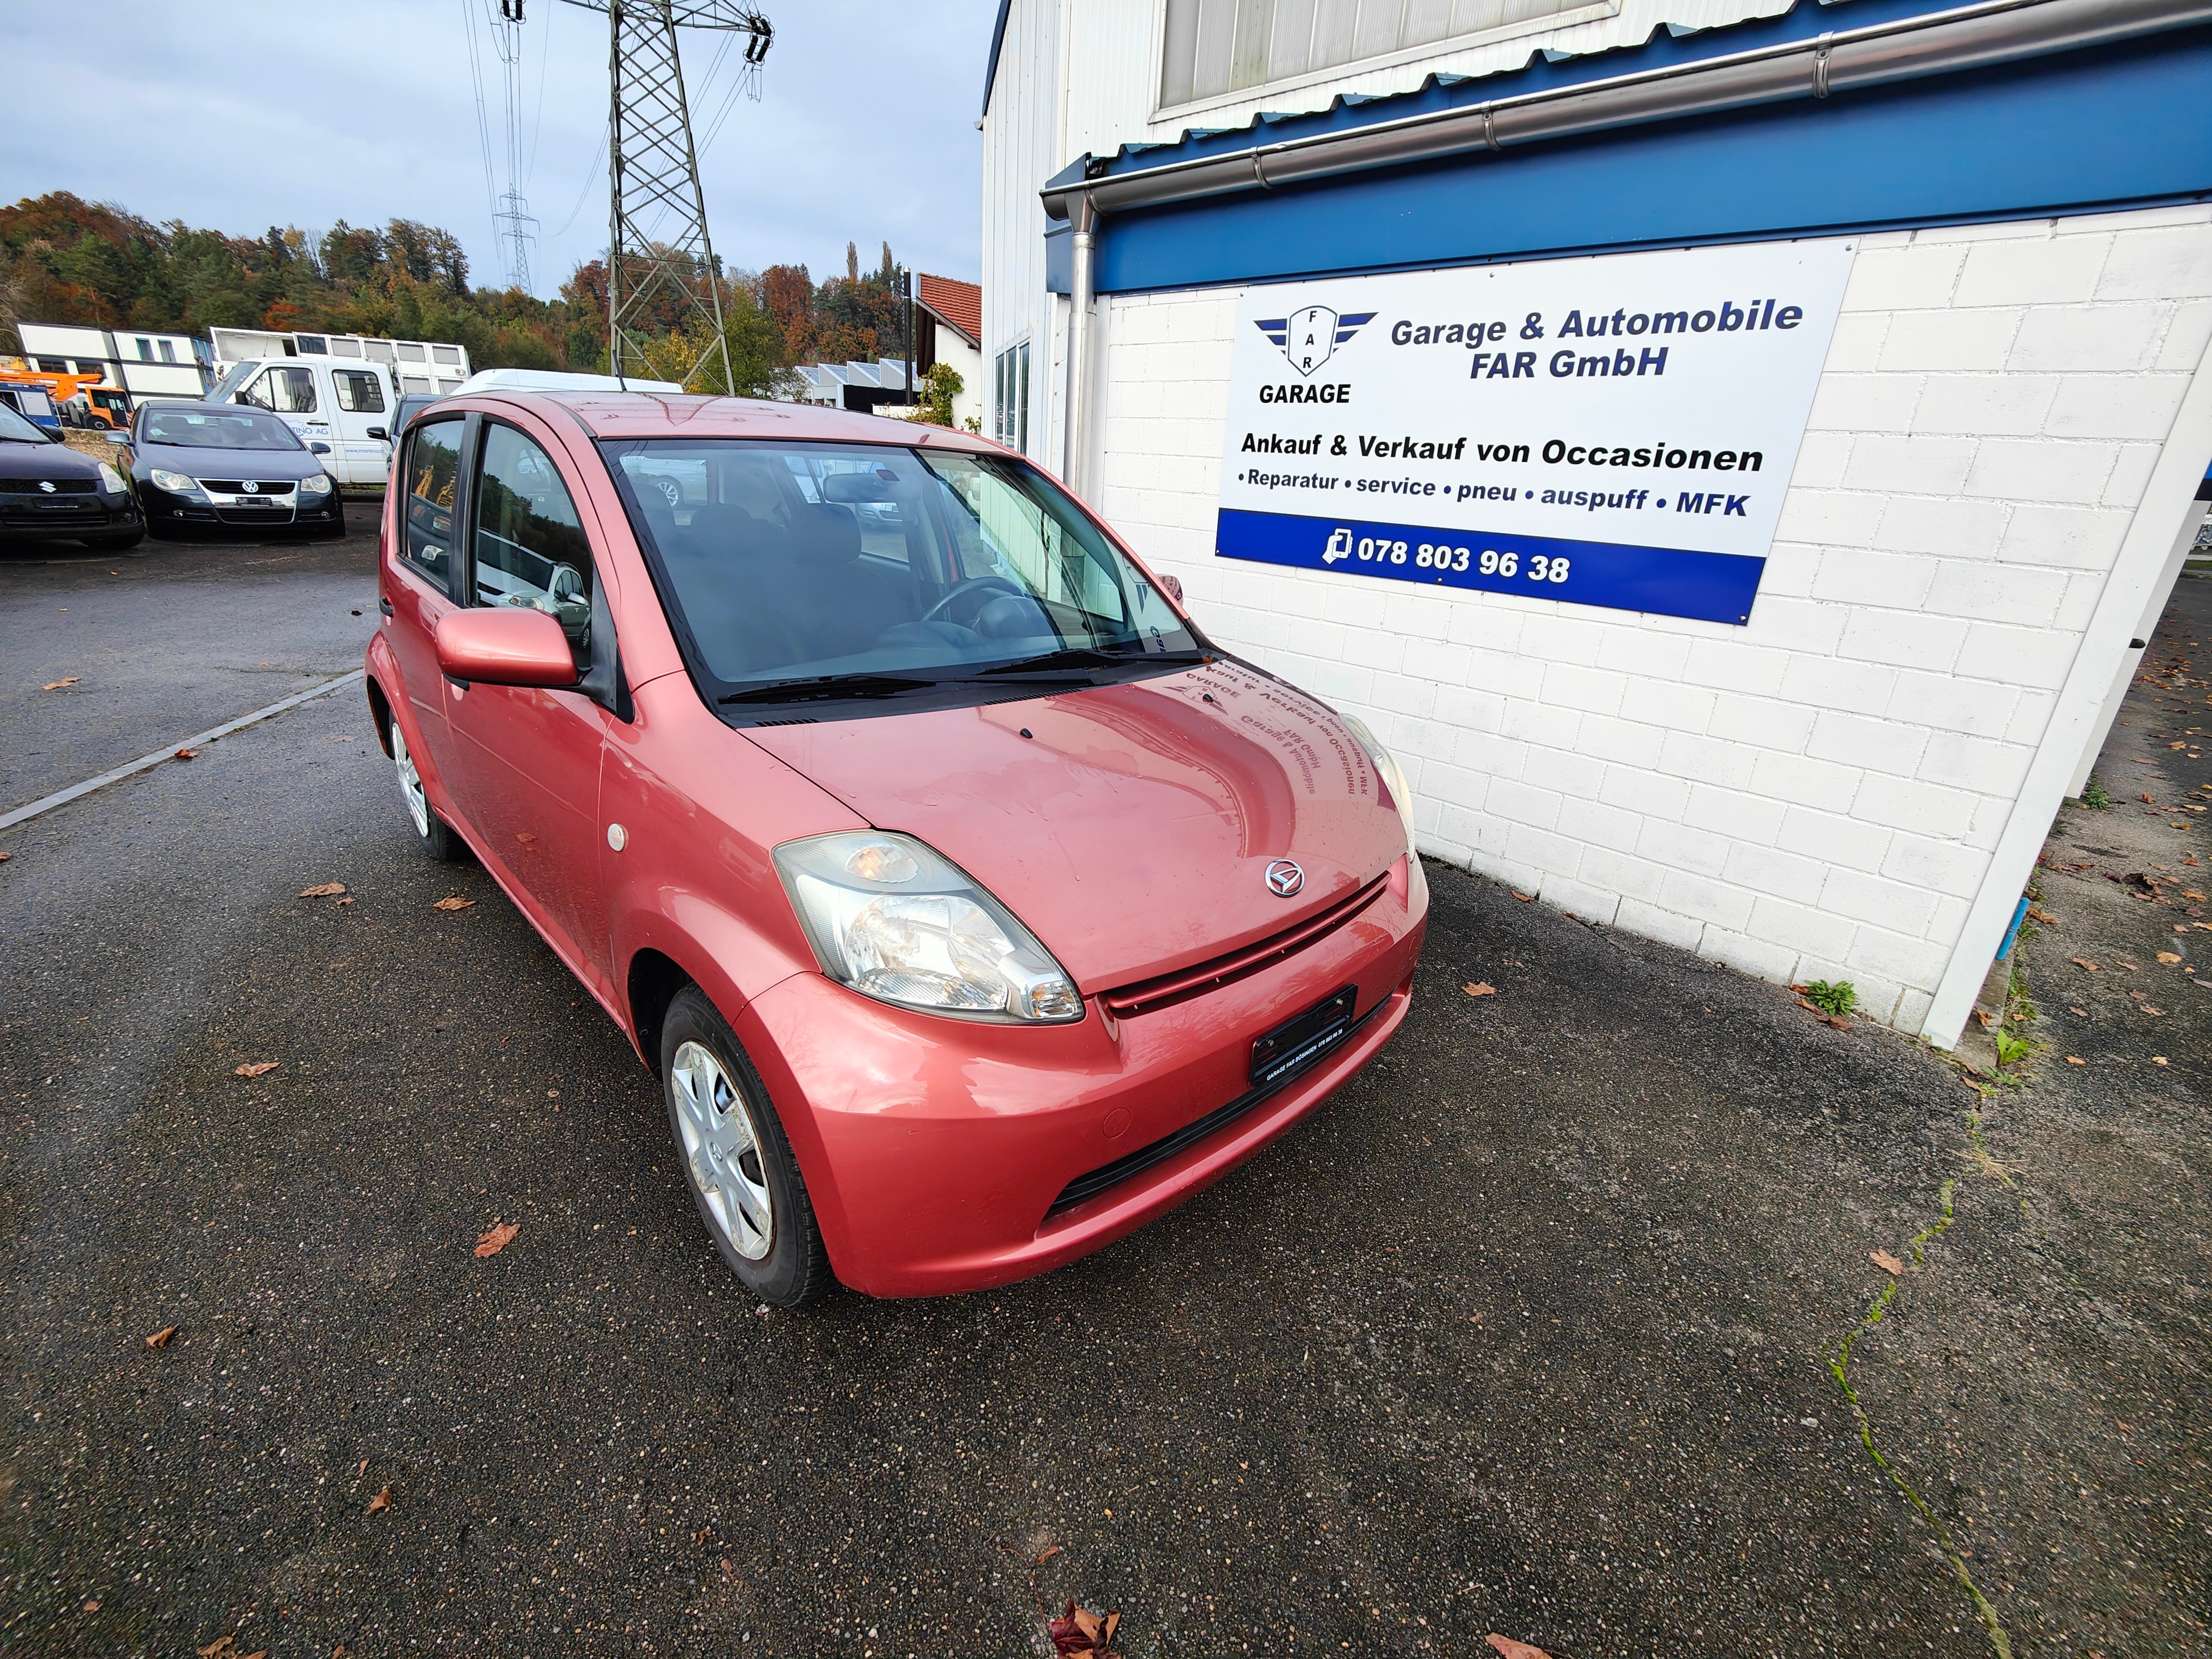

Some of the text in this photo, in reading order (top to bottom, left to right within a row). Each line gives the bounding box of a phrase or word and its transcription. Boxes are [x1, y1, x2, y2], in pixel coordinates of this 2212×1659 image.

[1391, 299, 1803, 350] Garage & Automobile
[1470, 347, 1669, 379] FAR GmbH
[1259, 383, 1351, 403] GARAGE
[1240, 433, 1763, 472] Ankauf & Verkauf von Occasionen
[1247, 469, 1751, 517] Reparatur service pneu auspuff MFK
[1358, 538, 1570, 583] 078 803 96 38
[1266, 1064, 1286, 1081] GARAGE
[1286, 1058, 1296, 1069] FAR
[1295, 1044, 1317, 1063] BÖSINGEN
